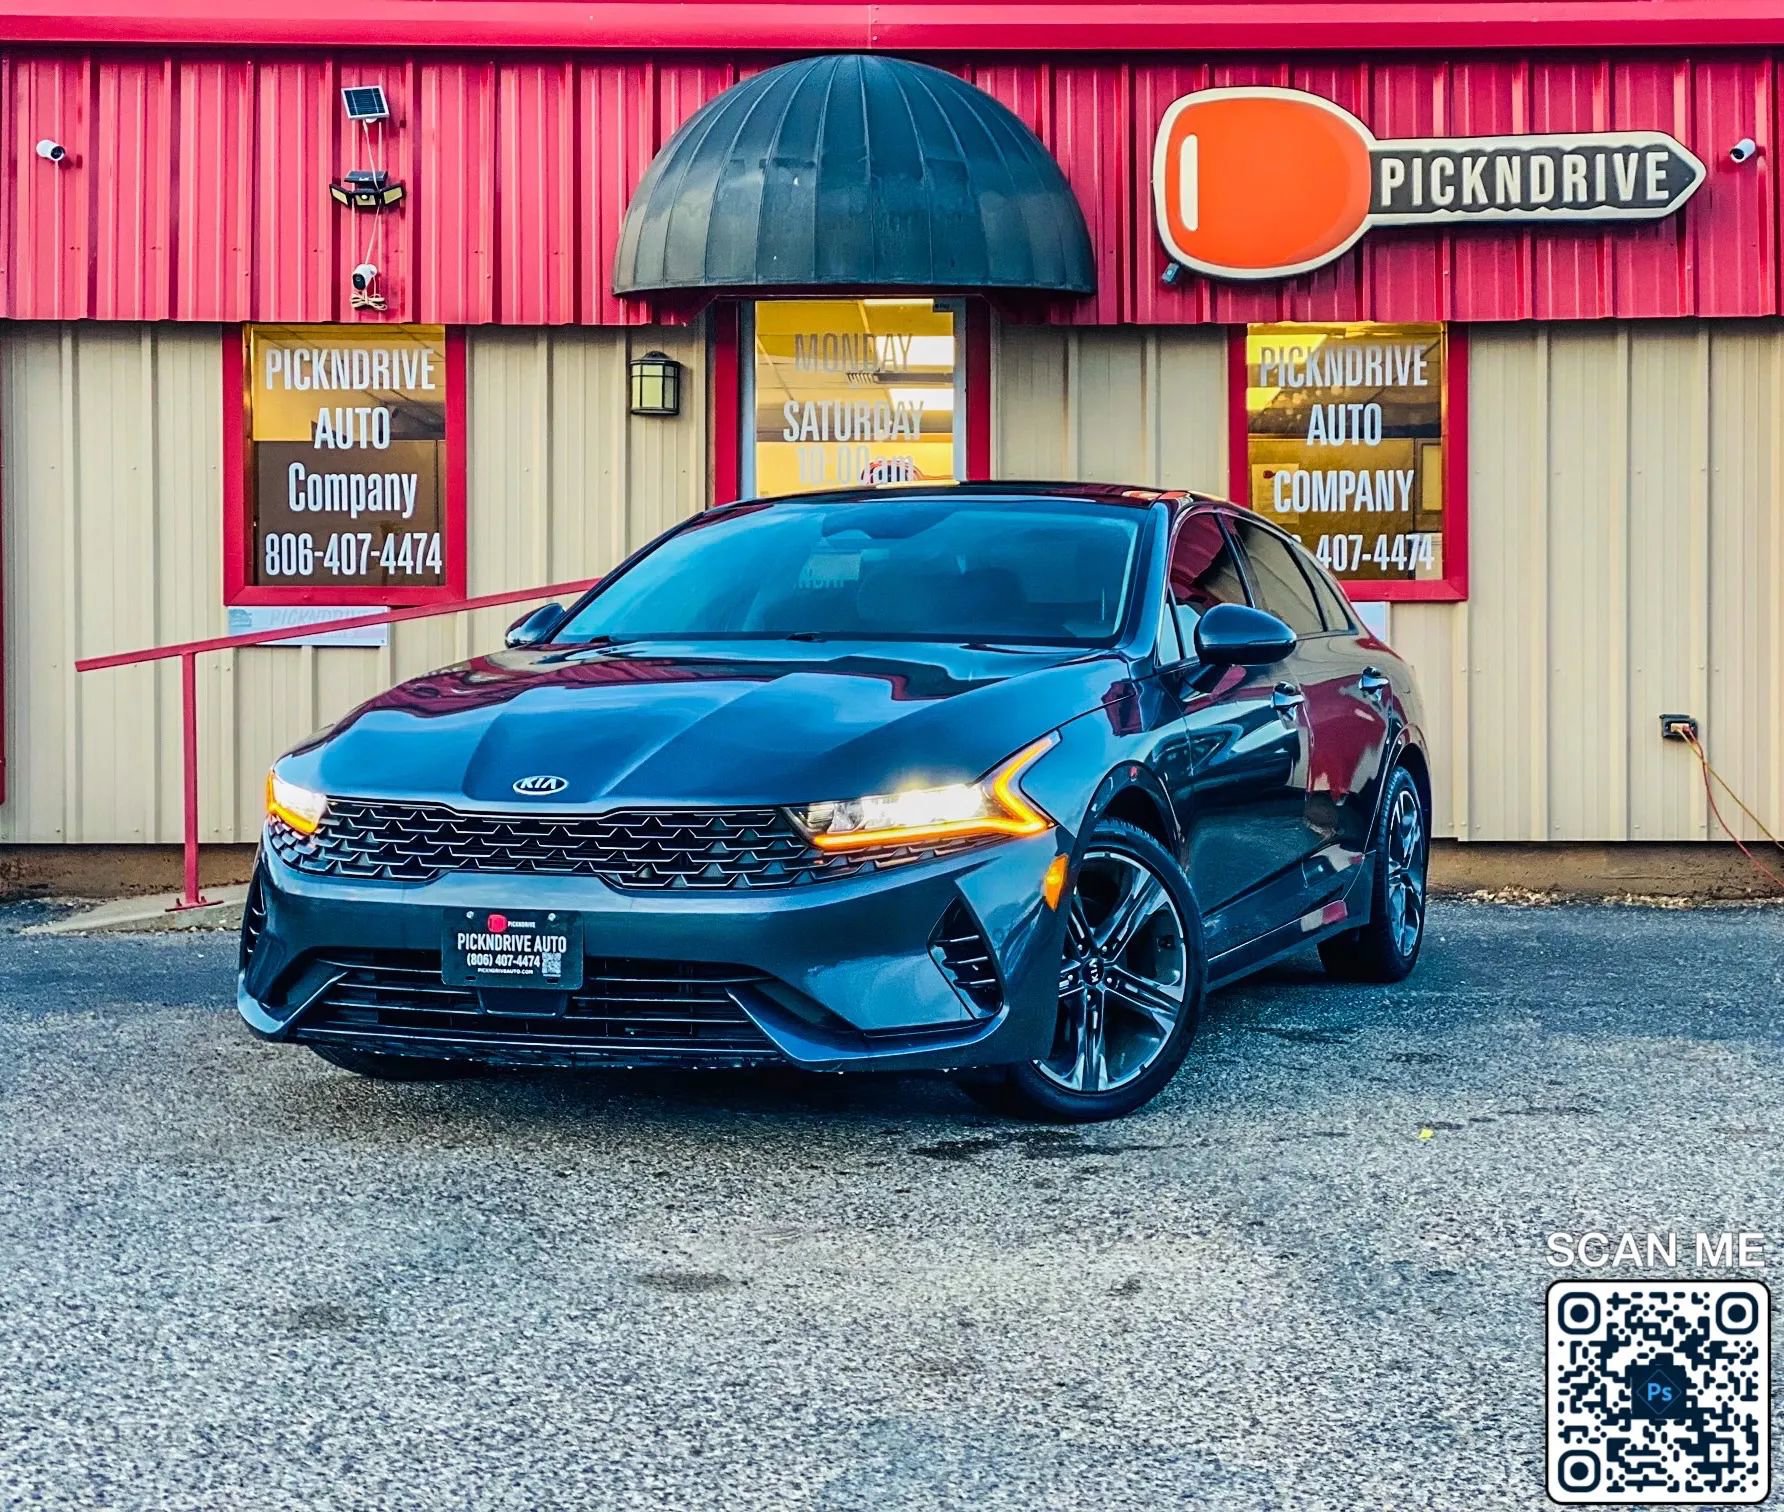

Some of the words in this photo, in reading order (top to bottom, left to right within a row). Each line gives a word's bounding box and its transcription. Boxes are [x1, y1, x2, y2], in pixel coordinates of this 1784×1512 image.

[1380, 151, 1669, 206] PICKNDRIVE
[265, 348, 436, 391] PICKNDRIVE
[794, 333, 914, 373] MONDAY
[1259, 344, 1429, 388] PICKNDRIVE
[313, 406, 391, 450] AUTO
[783, 399, 924, 442] SATURDAY
[1306, 403, 1383, 447] AUTO
[288, 461, 418, 520] Company
[1273, 469, 1415, 514] COMPANY
[265, 532, 443, 577] 806-407-4474
[457, 932, 531, 952] PICKNDRIVE
[533, 935, 567, 954] AUTO
[466, 952, 493, 967] (806)
[495, 953, 541, 968] 407-4474
